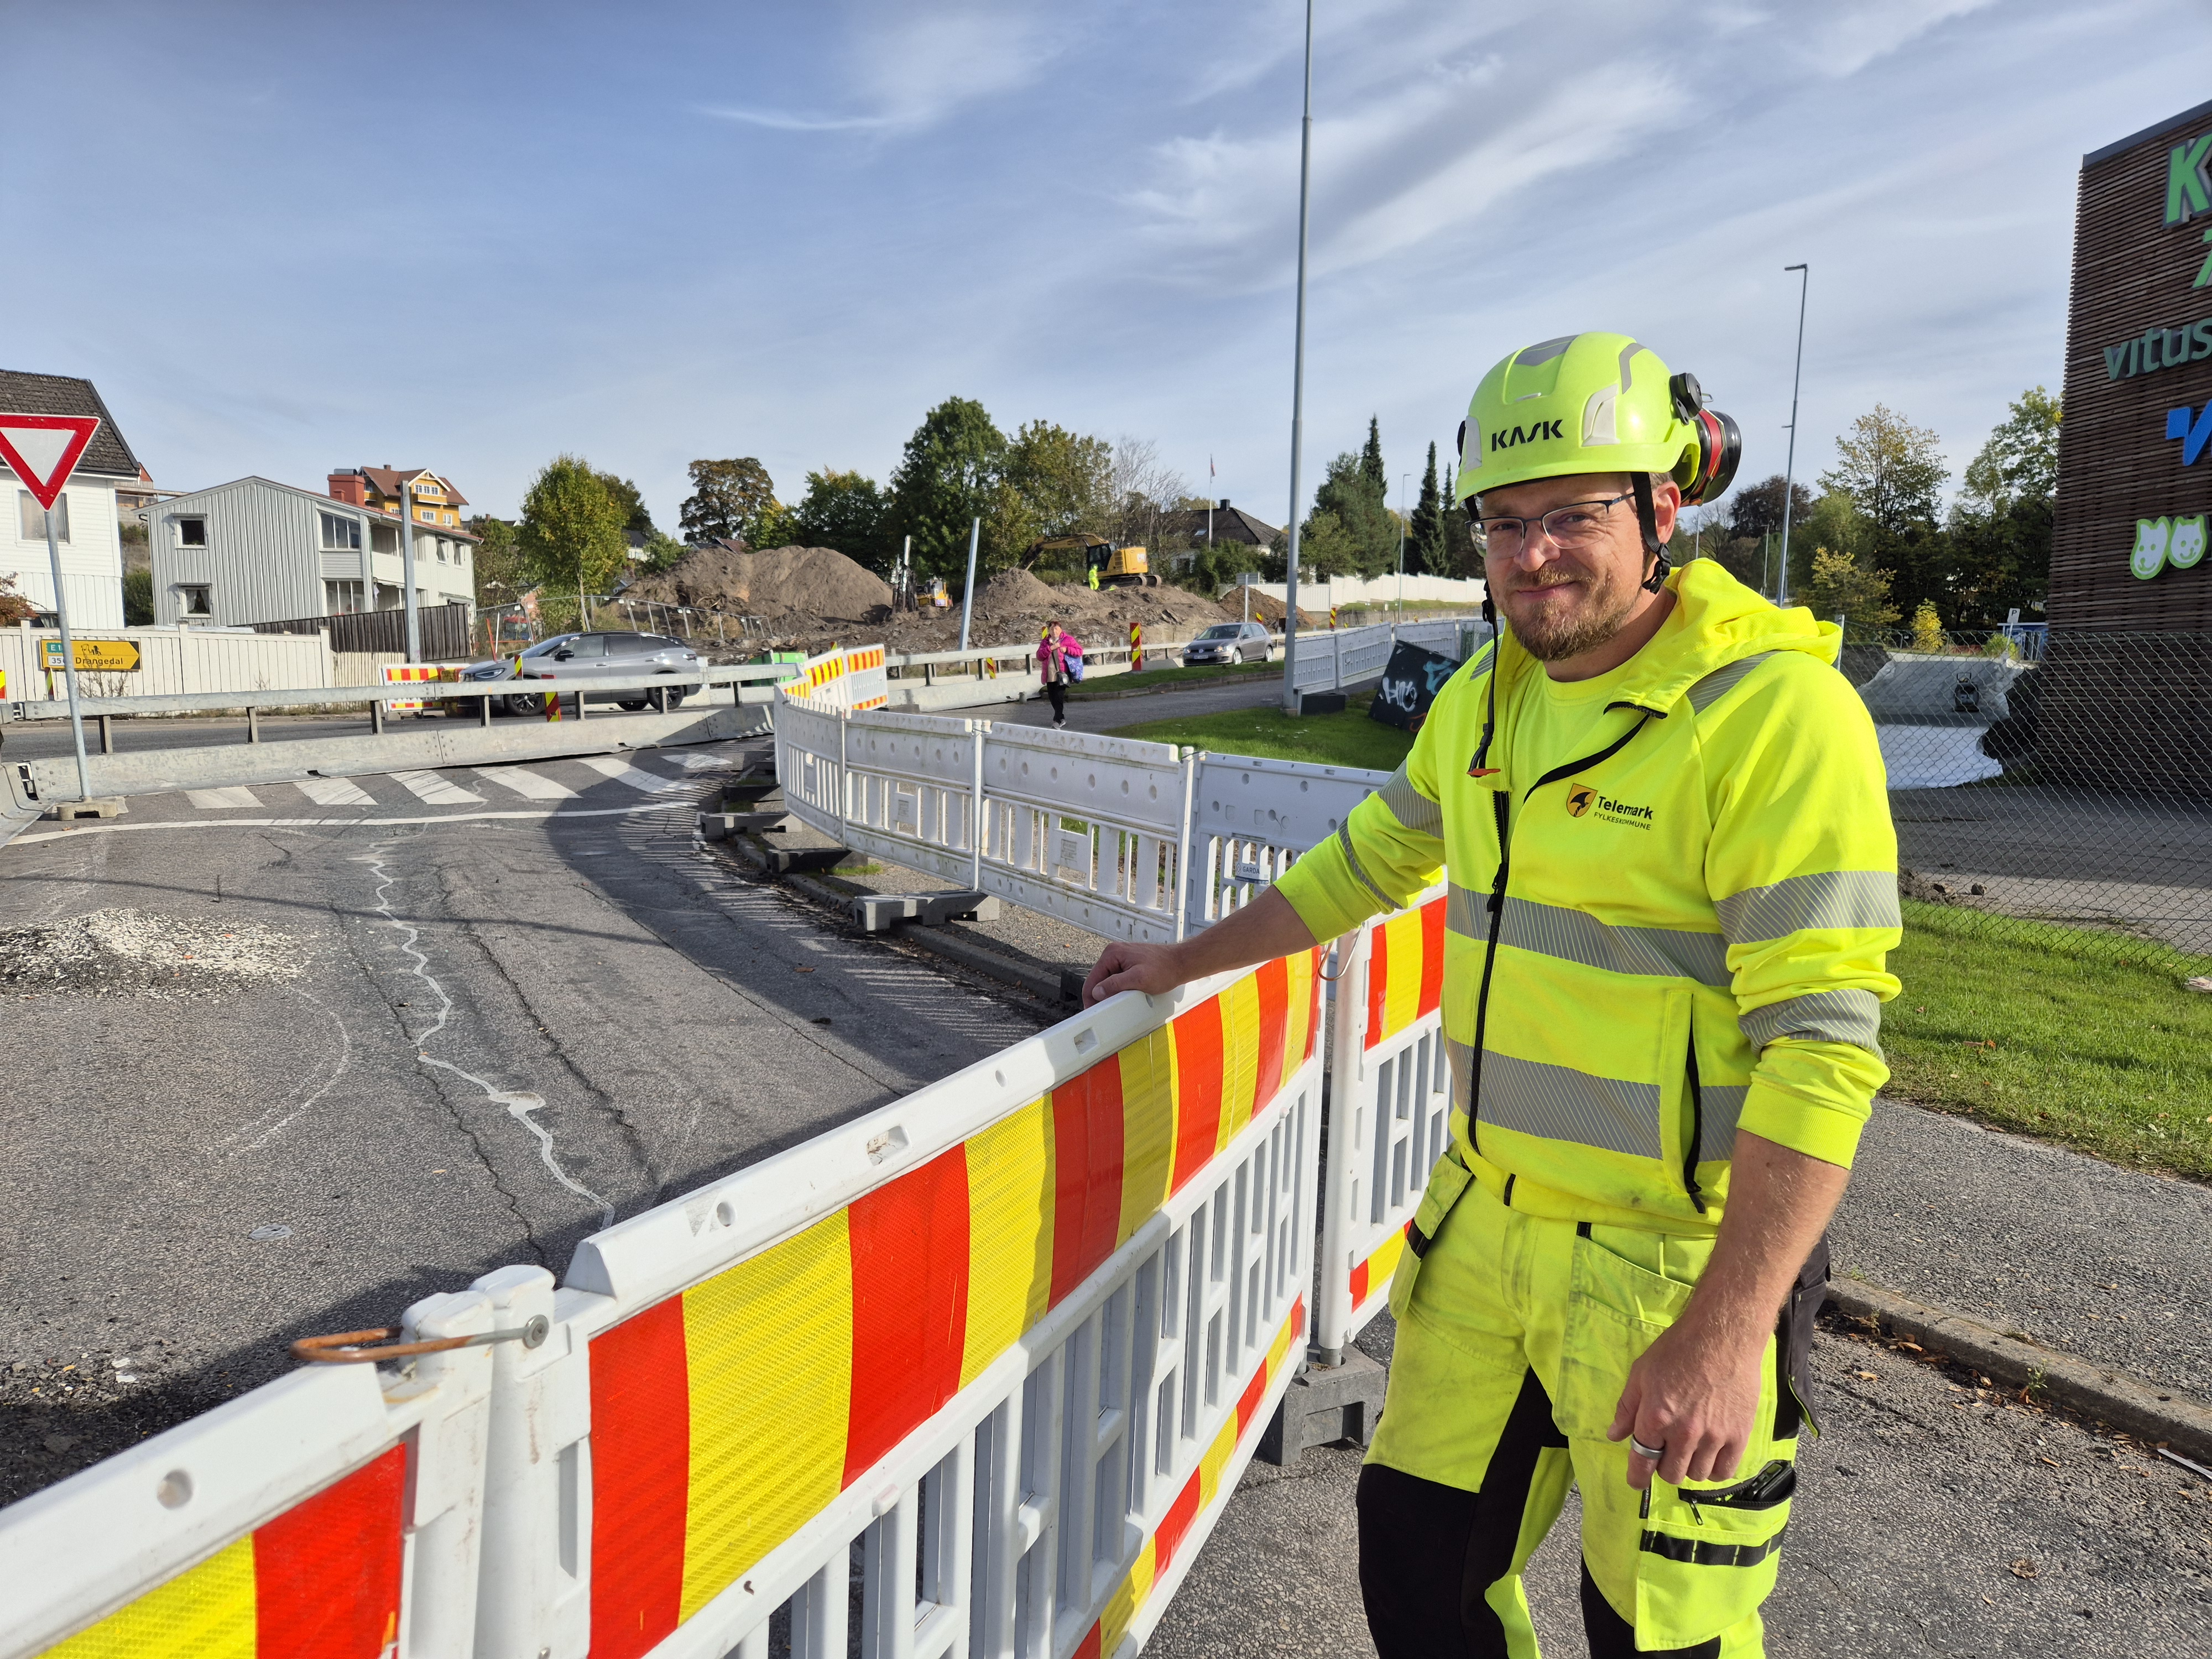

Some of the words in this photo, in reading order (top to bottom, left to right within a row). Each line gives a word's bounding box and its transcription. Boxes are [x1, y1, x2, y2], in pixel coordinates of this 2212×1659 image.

[1491, 419, 1564, 452] KASK
[75, 657, 123, 666] Drangedal
[1598, 796, 1653, 820] Telemark
[1594, 812, 1651, 831] FYLKESKOMMUNE
[1242, 866, 1260, 874] GARDA
